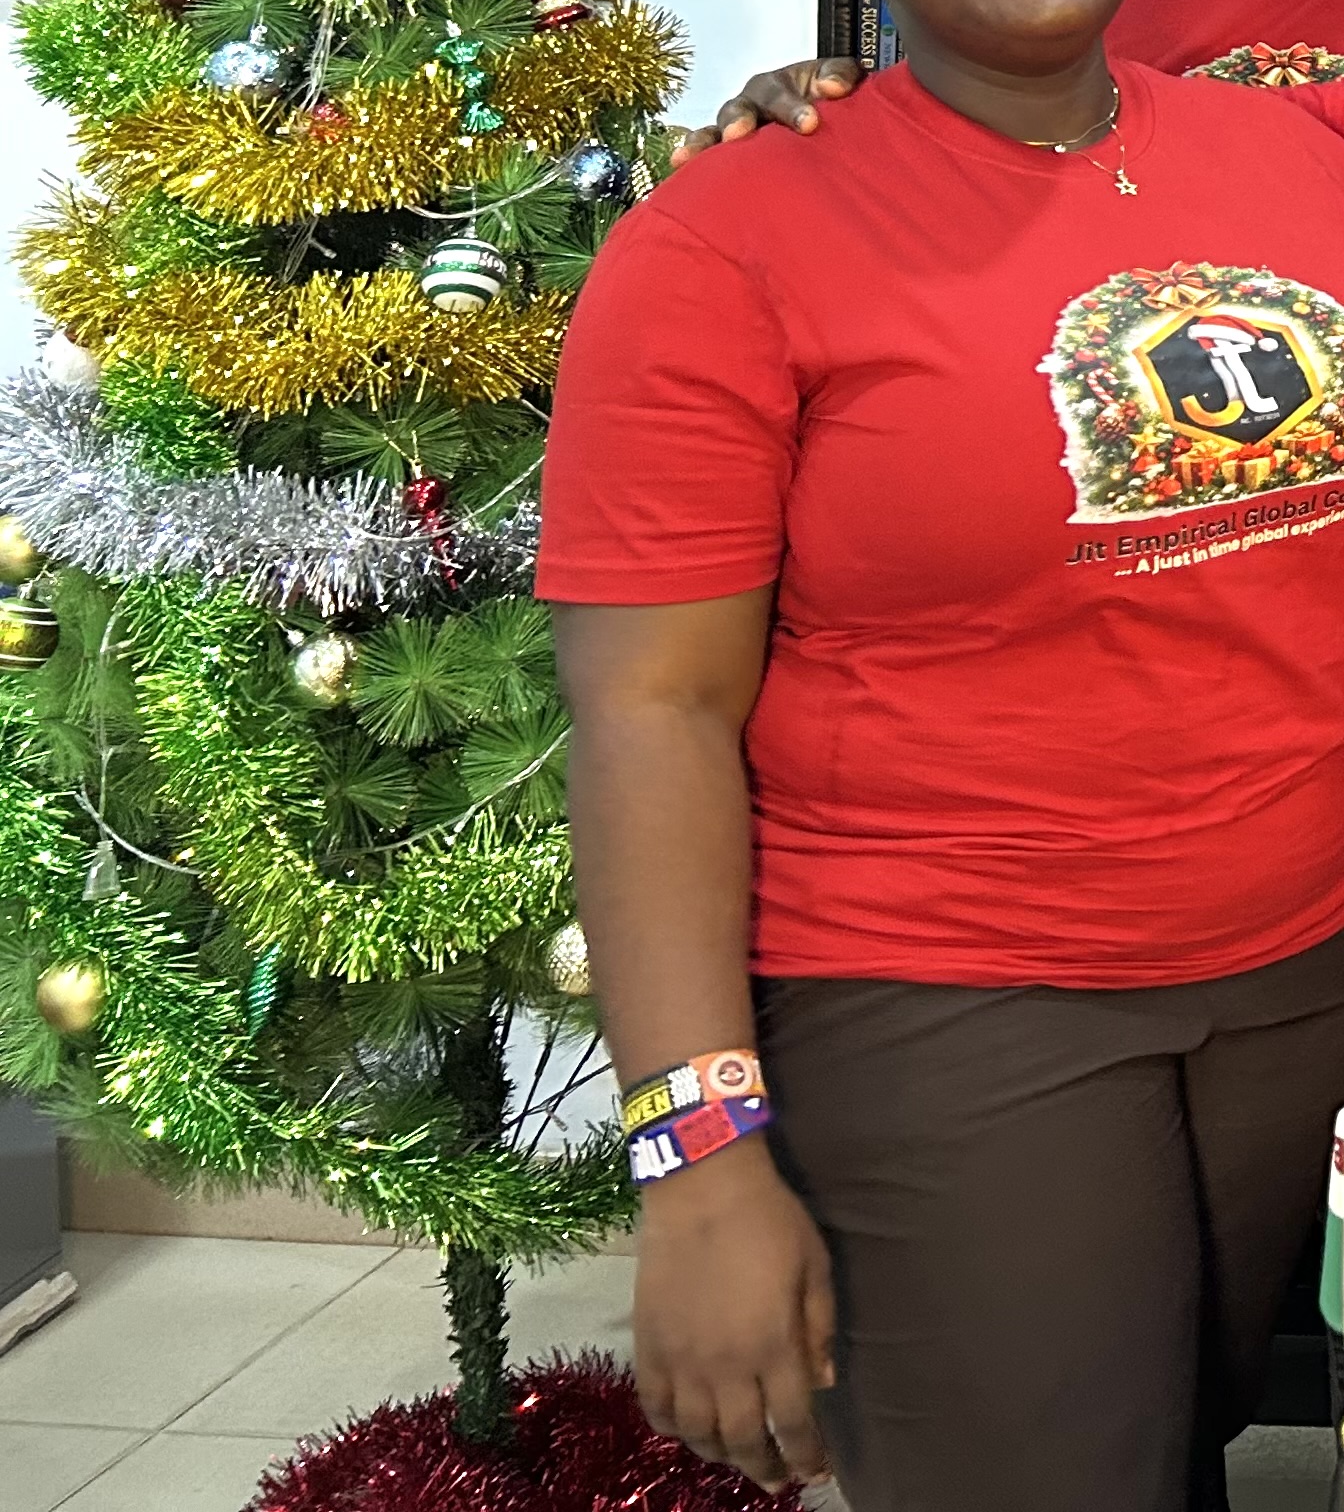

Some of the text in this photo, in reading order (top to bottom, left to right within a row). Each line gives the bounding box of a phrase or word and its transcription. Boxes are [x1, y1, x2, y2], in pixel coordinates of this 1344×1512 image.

[1065, 540, 1106, 567] Jit
[1114, 518, 1236, 559] Empirical
[1243, 493, 1316, 530] Global
[1135, 558, 1151, 574] A
[1151, 552, 1192, 577] just
[1192, 548, 1209, 564] in
[1209, 539, 1240, 559] time
[1241, 524, 1289, 552] global
